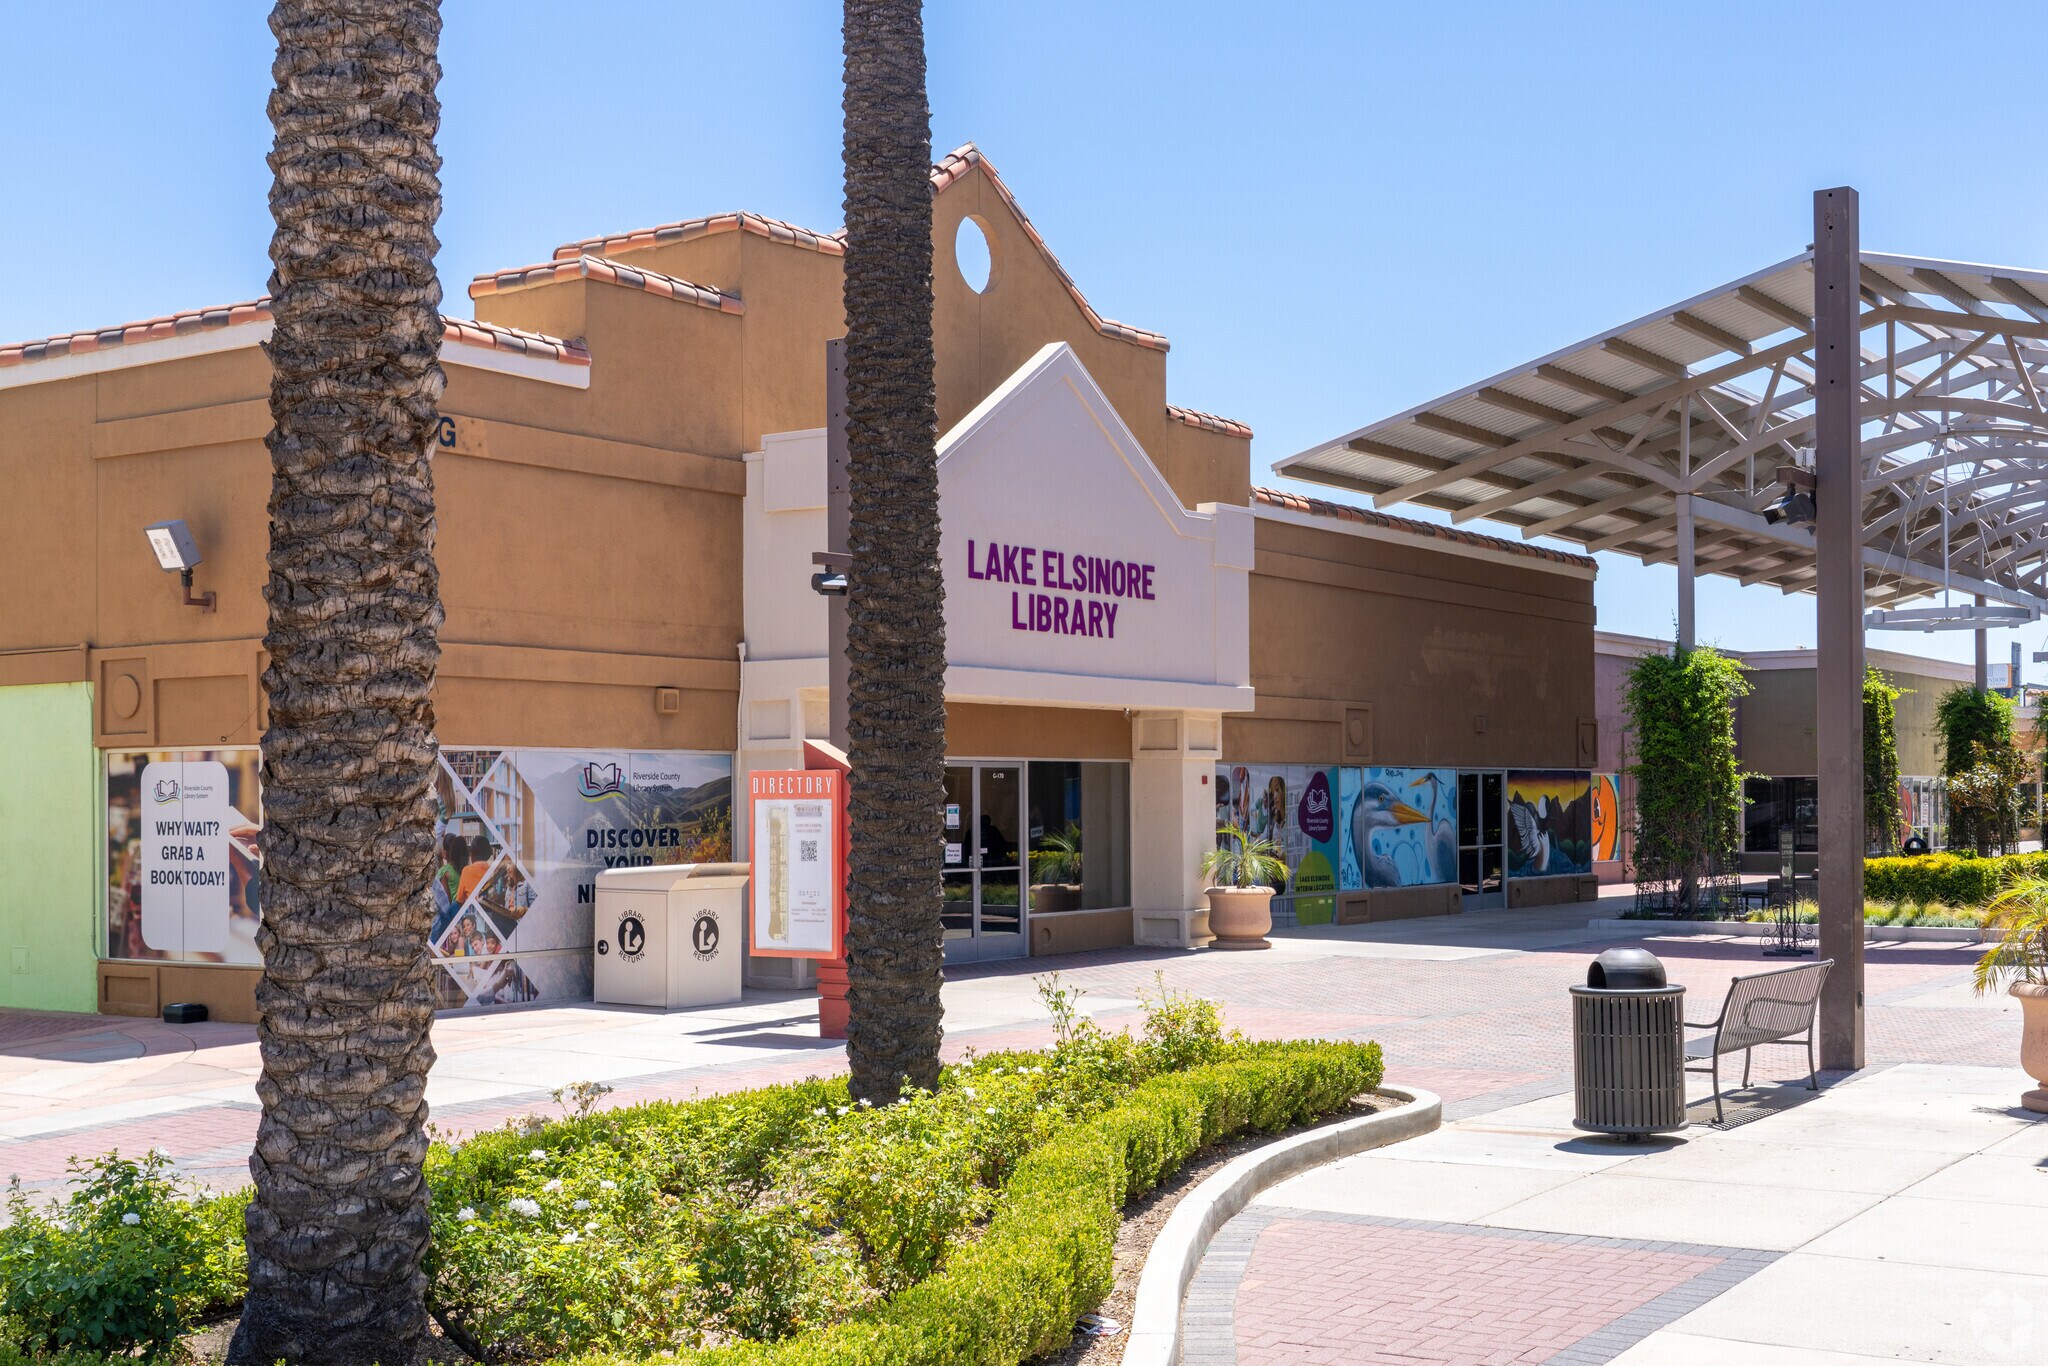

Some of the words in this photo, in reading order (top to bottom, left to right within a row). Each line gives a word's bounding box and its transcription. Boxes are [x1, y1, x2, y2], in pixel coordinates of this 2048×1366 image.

[968, 539, 1037, 586] LAKE
[1043, 550, 1156, 601] ELSINORE
[1012, 591, 1119, 639] LIBRARY
[633, 772, 660, 781] Riverside
[660, 773, 681, 783] County
[633, 784, 652, 793] Library
[653, 784, 673, 793] System
[752, 776, 833, 795] DIRECTORY
[156, 821, 182, 835] WHY
[184, 822, 219, 836] WAIT?
[587, 828, 680, 849] DISCOVER
[162, 846, 193, 860] GRAB
[197, 847, 204, 861] A
[151, 870, 183, 884] BOOK
[185, 871, 225, 886] TODAY!
[618, 910, 645, 923] LIBRARY
[693, 909, 719, 922] LIBRARY
[618, 951, 645, 963] RETURN
[693, 948, 719, 962] RETURN
